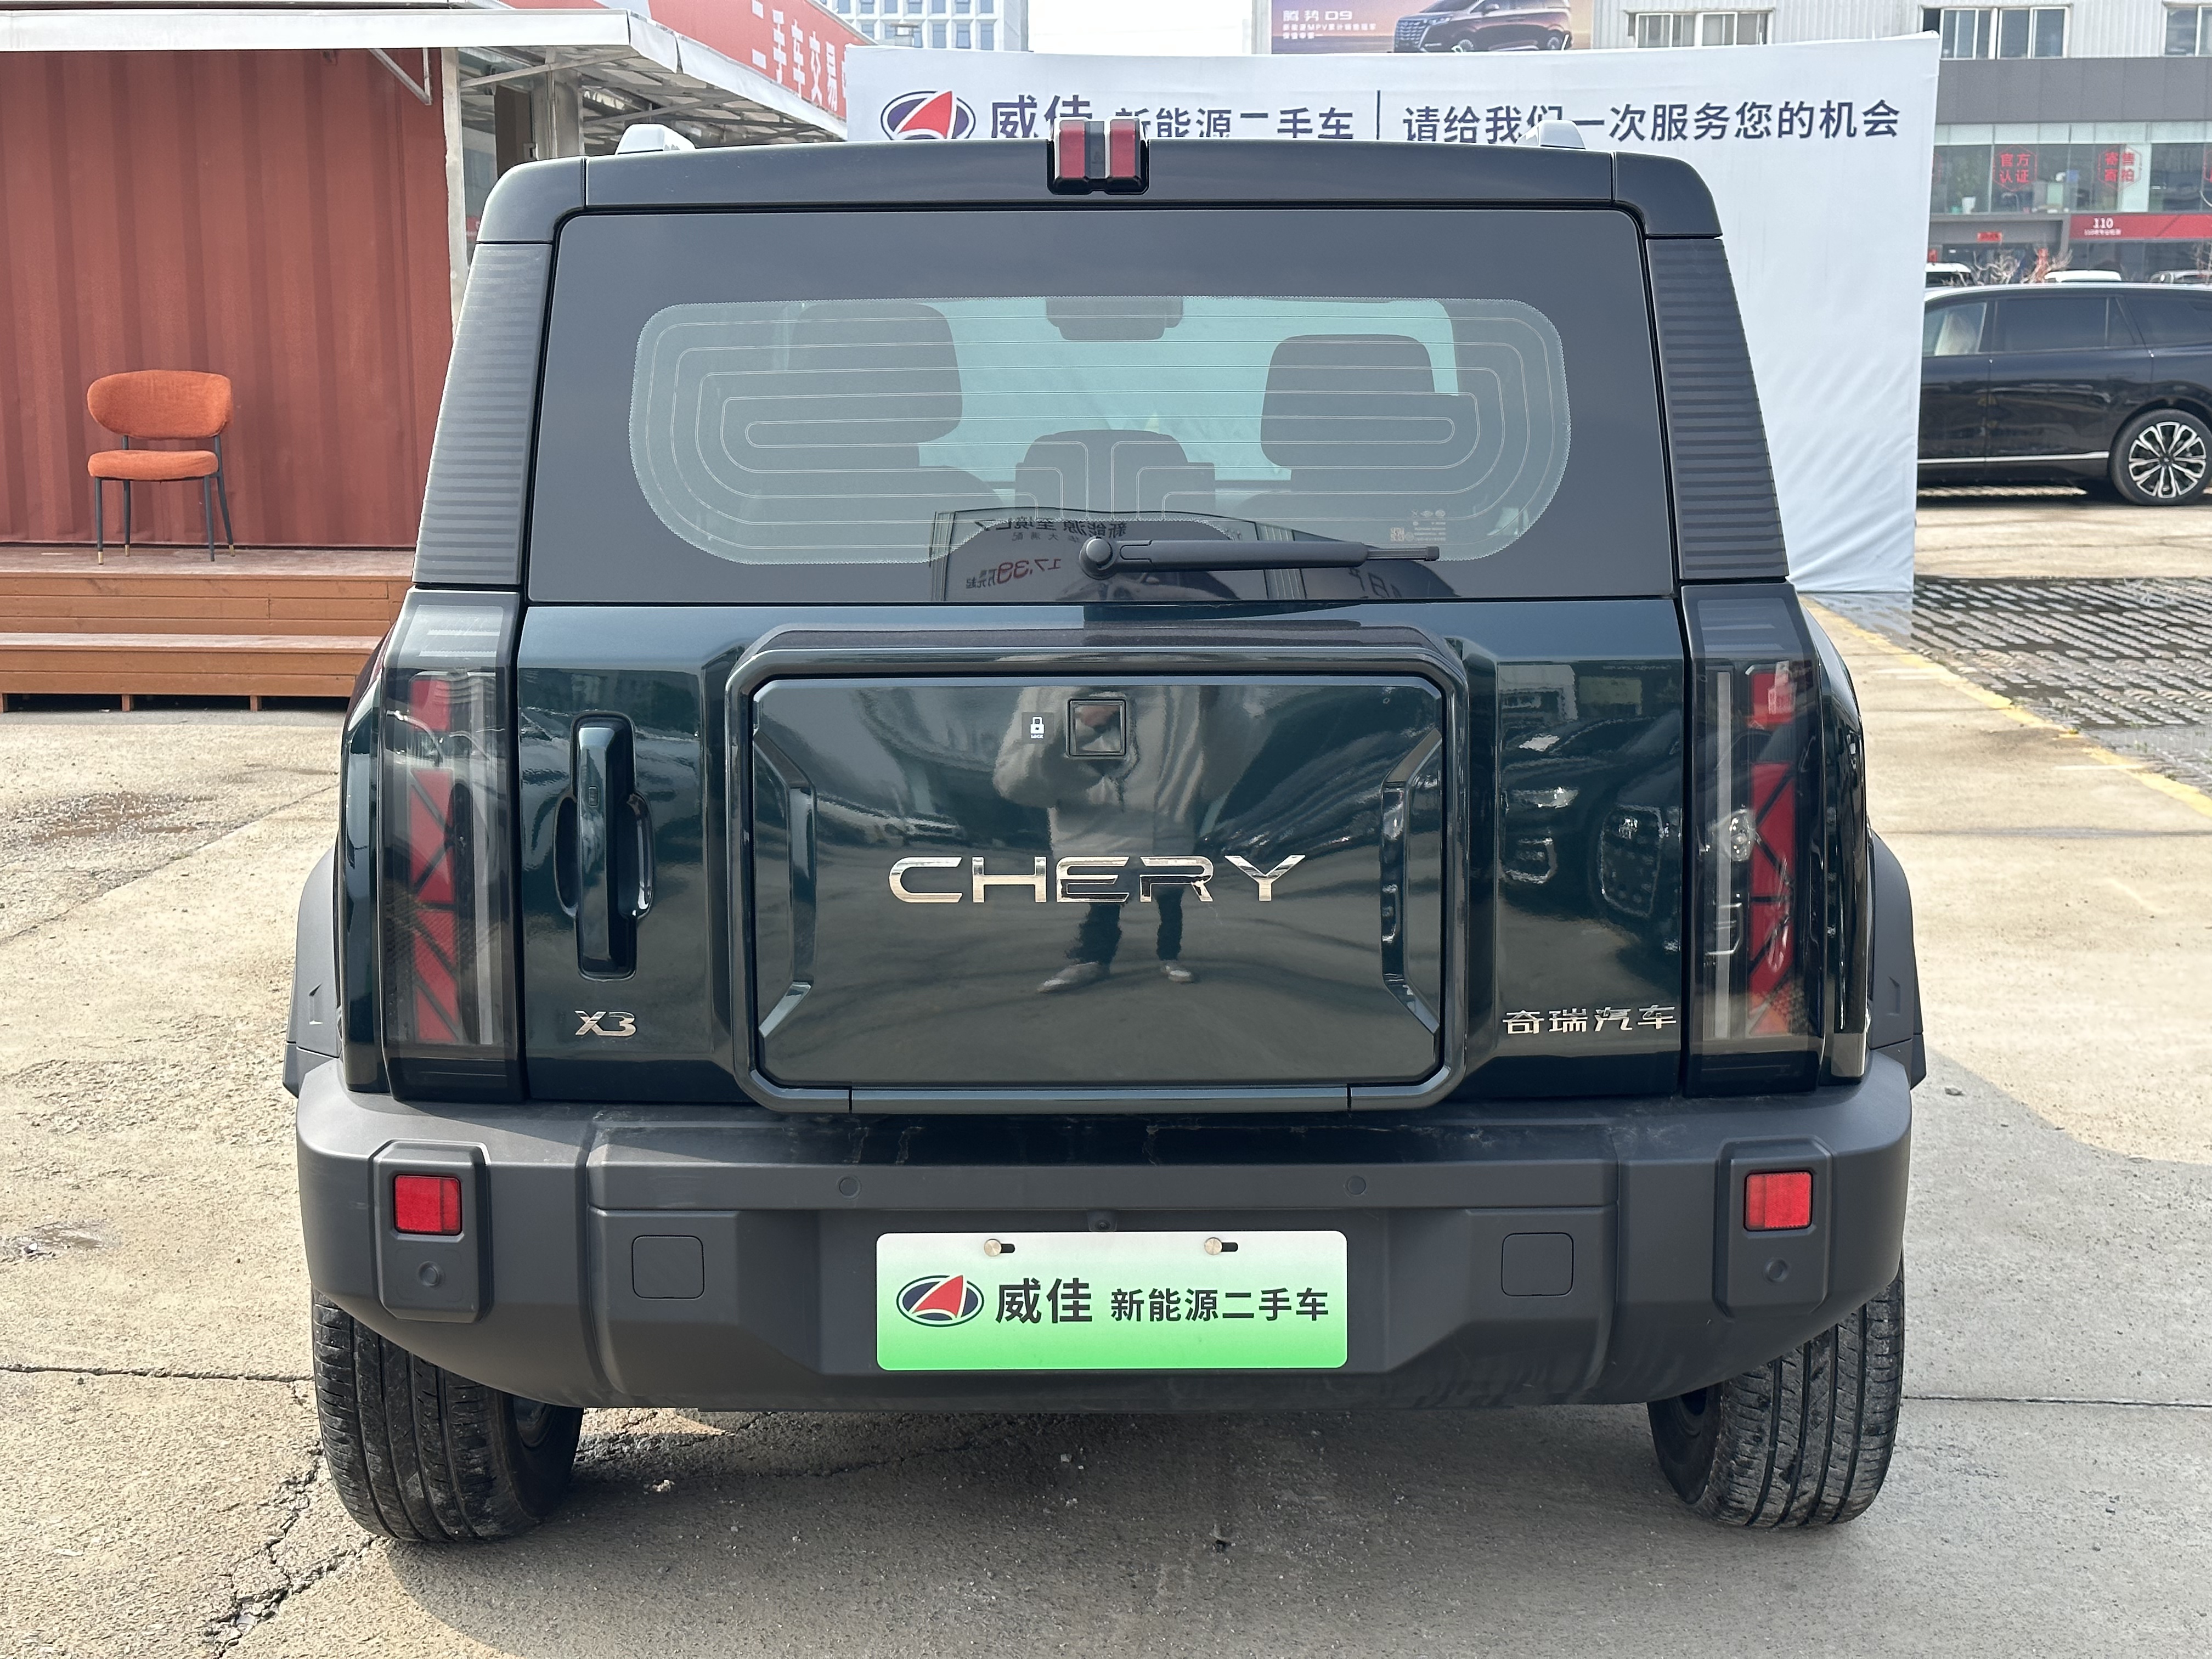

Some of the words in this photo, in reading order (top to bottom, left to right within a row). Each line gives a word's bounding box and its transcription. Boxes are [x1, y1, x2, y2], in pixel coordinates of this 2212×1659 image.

[751, 0, 847, 111] 二手车交易
[889, 855, 1306, 903] CHERY
[575, 1011, 636, 1036] X3
[1502, 1005, 1677, 1034] 奇瑞汽车
[995, 1278, 1092, 1324] 威佳
[1110, 1288, 1329, 1322] 新能源二手车
